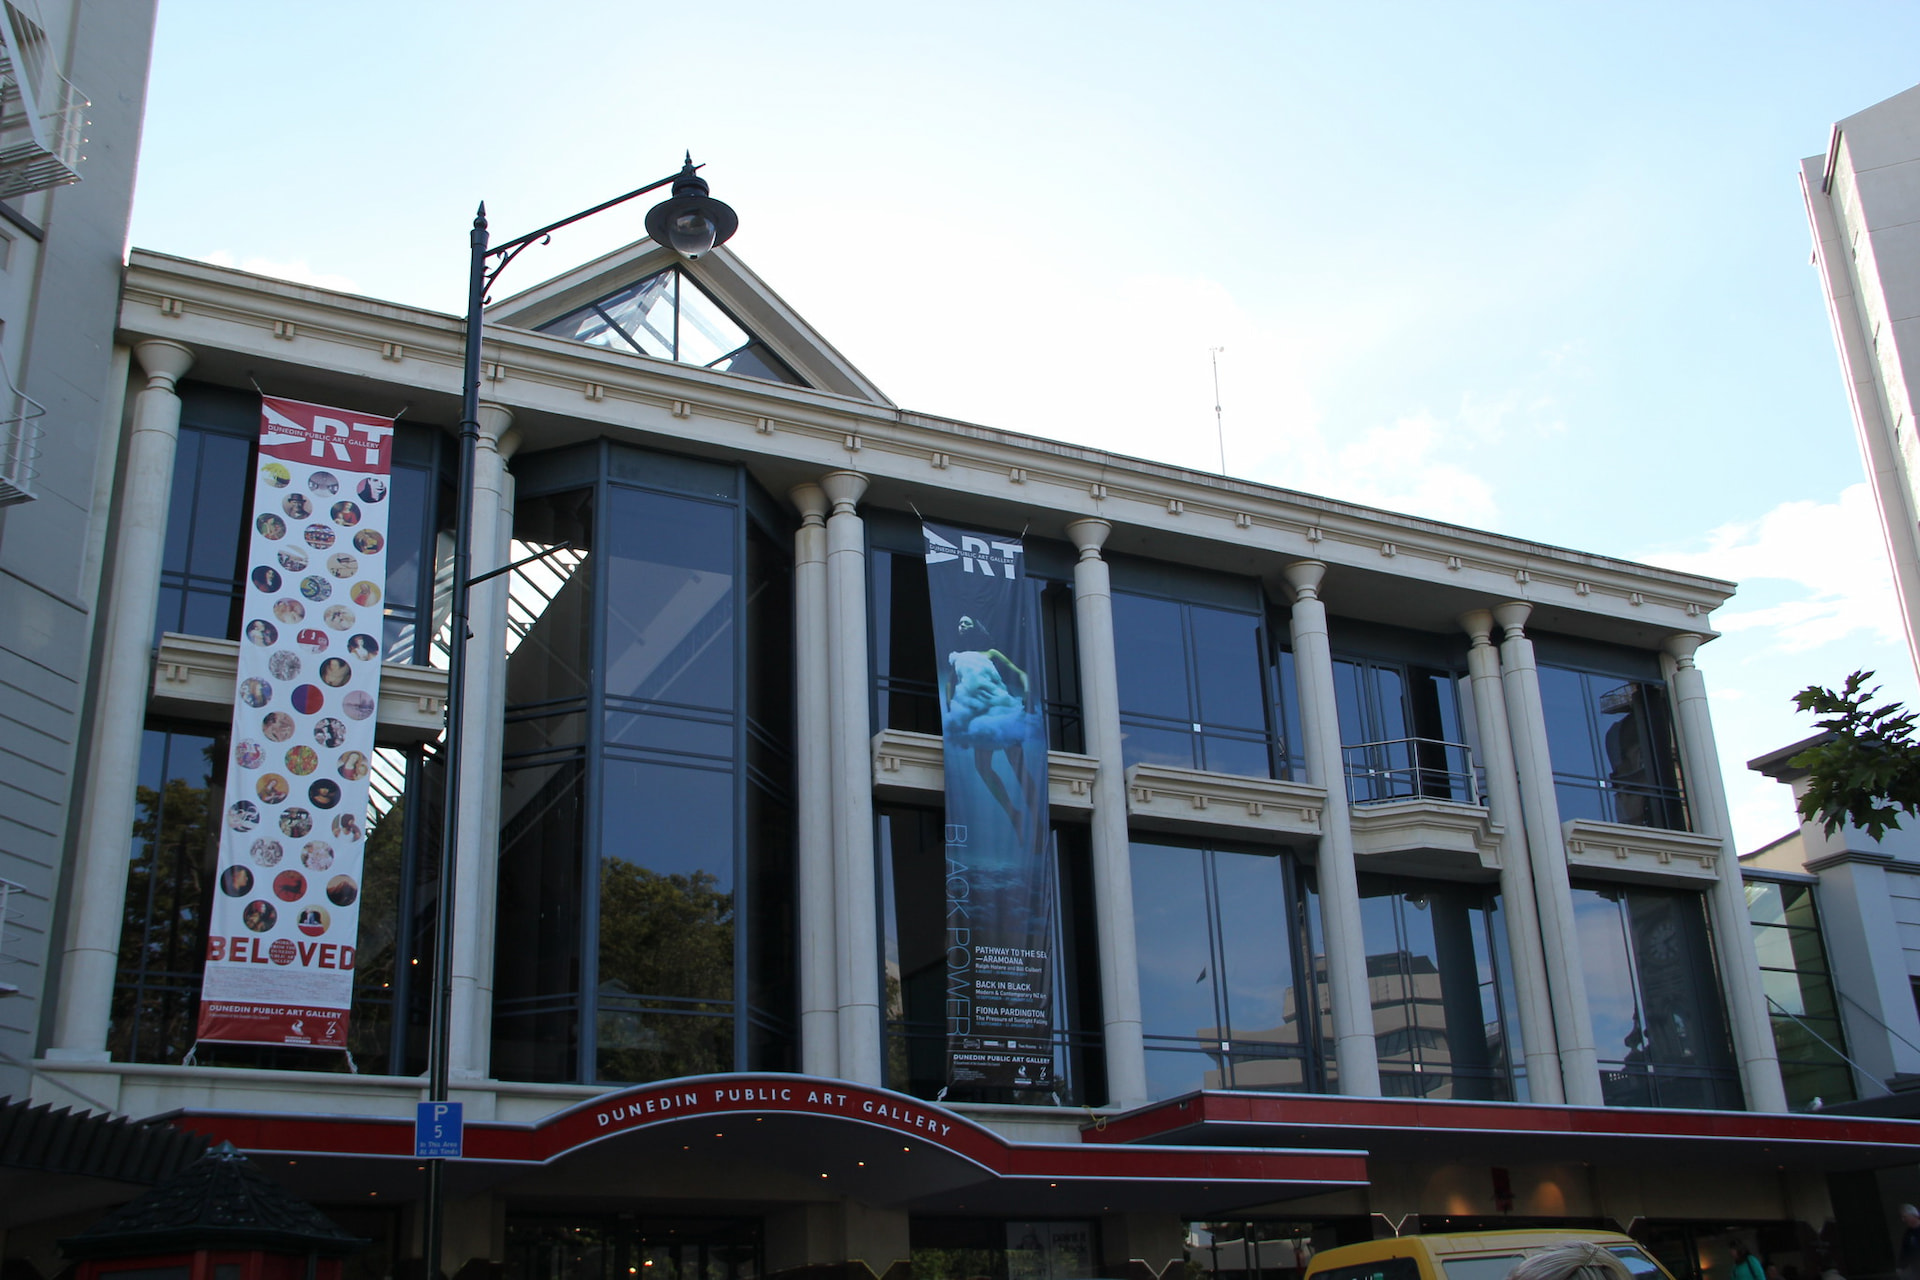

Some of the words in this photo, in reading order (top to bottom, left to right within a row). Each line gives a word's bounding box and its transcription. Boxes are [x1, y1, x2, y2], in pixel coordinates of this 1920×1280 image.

[268, 424, 303, 437] DUNEDIN
[304, 431, 331, 442] PUBLIC
[332, 436, 347, 444] ART
[348, 438, 380, 449] GALLERY
[929, 544, 957, 555] DUNEDIN
[957, 549, 977, 559] PUBLIC
[989, 555, 1014, 564] GALLERY
[945, 824, 970, 920] BLACK
[206, 936, 356, 971] BELOVED
[975, 946, 1010, 955] PATHWAY
[1011, 948, 1020, 956] TO
[1020, 949, 1035, 958] THE
[945, 927, 972, 1036] POWER
[976, 980, 996, 989] BACK
[997, 981, 1006, 990] IN
[1007, 982, 1032, 991] BLACK
[209, 1004, 251, 1013] DUNEDIN
[253, 1006, 284, 1015] PUBLIC
[286, 1009, 304, 1017] ART
[306, 1010, 342, 1019] GALLERY
[976, 1006, 999, 1016] FIONA
[1000, 1007, 1045, 1018] PARDINGTON
[1025, 1057, 1051, 1065] GALLERY
[434, 1104, 449, 1122] P
[597, 1092, 699, 1127] DUNEDIN
[715, 1088, 791, 1102] PUBLIC
[807, 1090, 848, 1107] ART
[863, 1100, 951, 1138] GALLERY
[434, 1124, 443, 1139] 5
